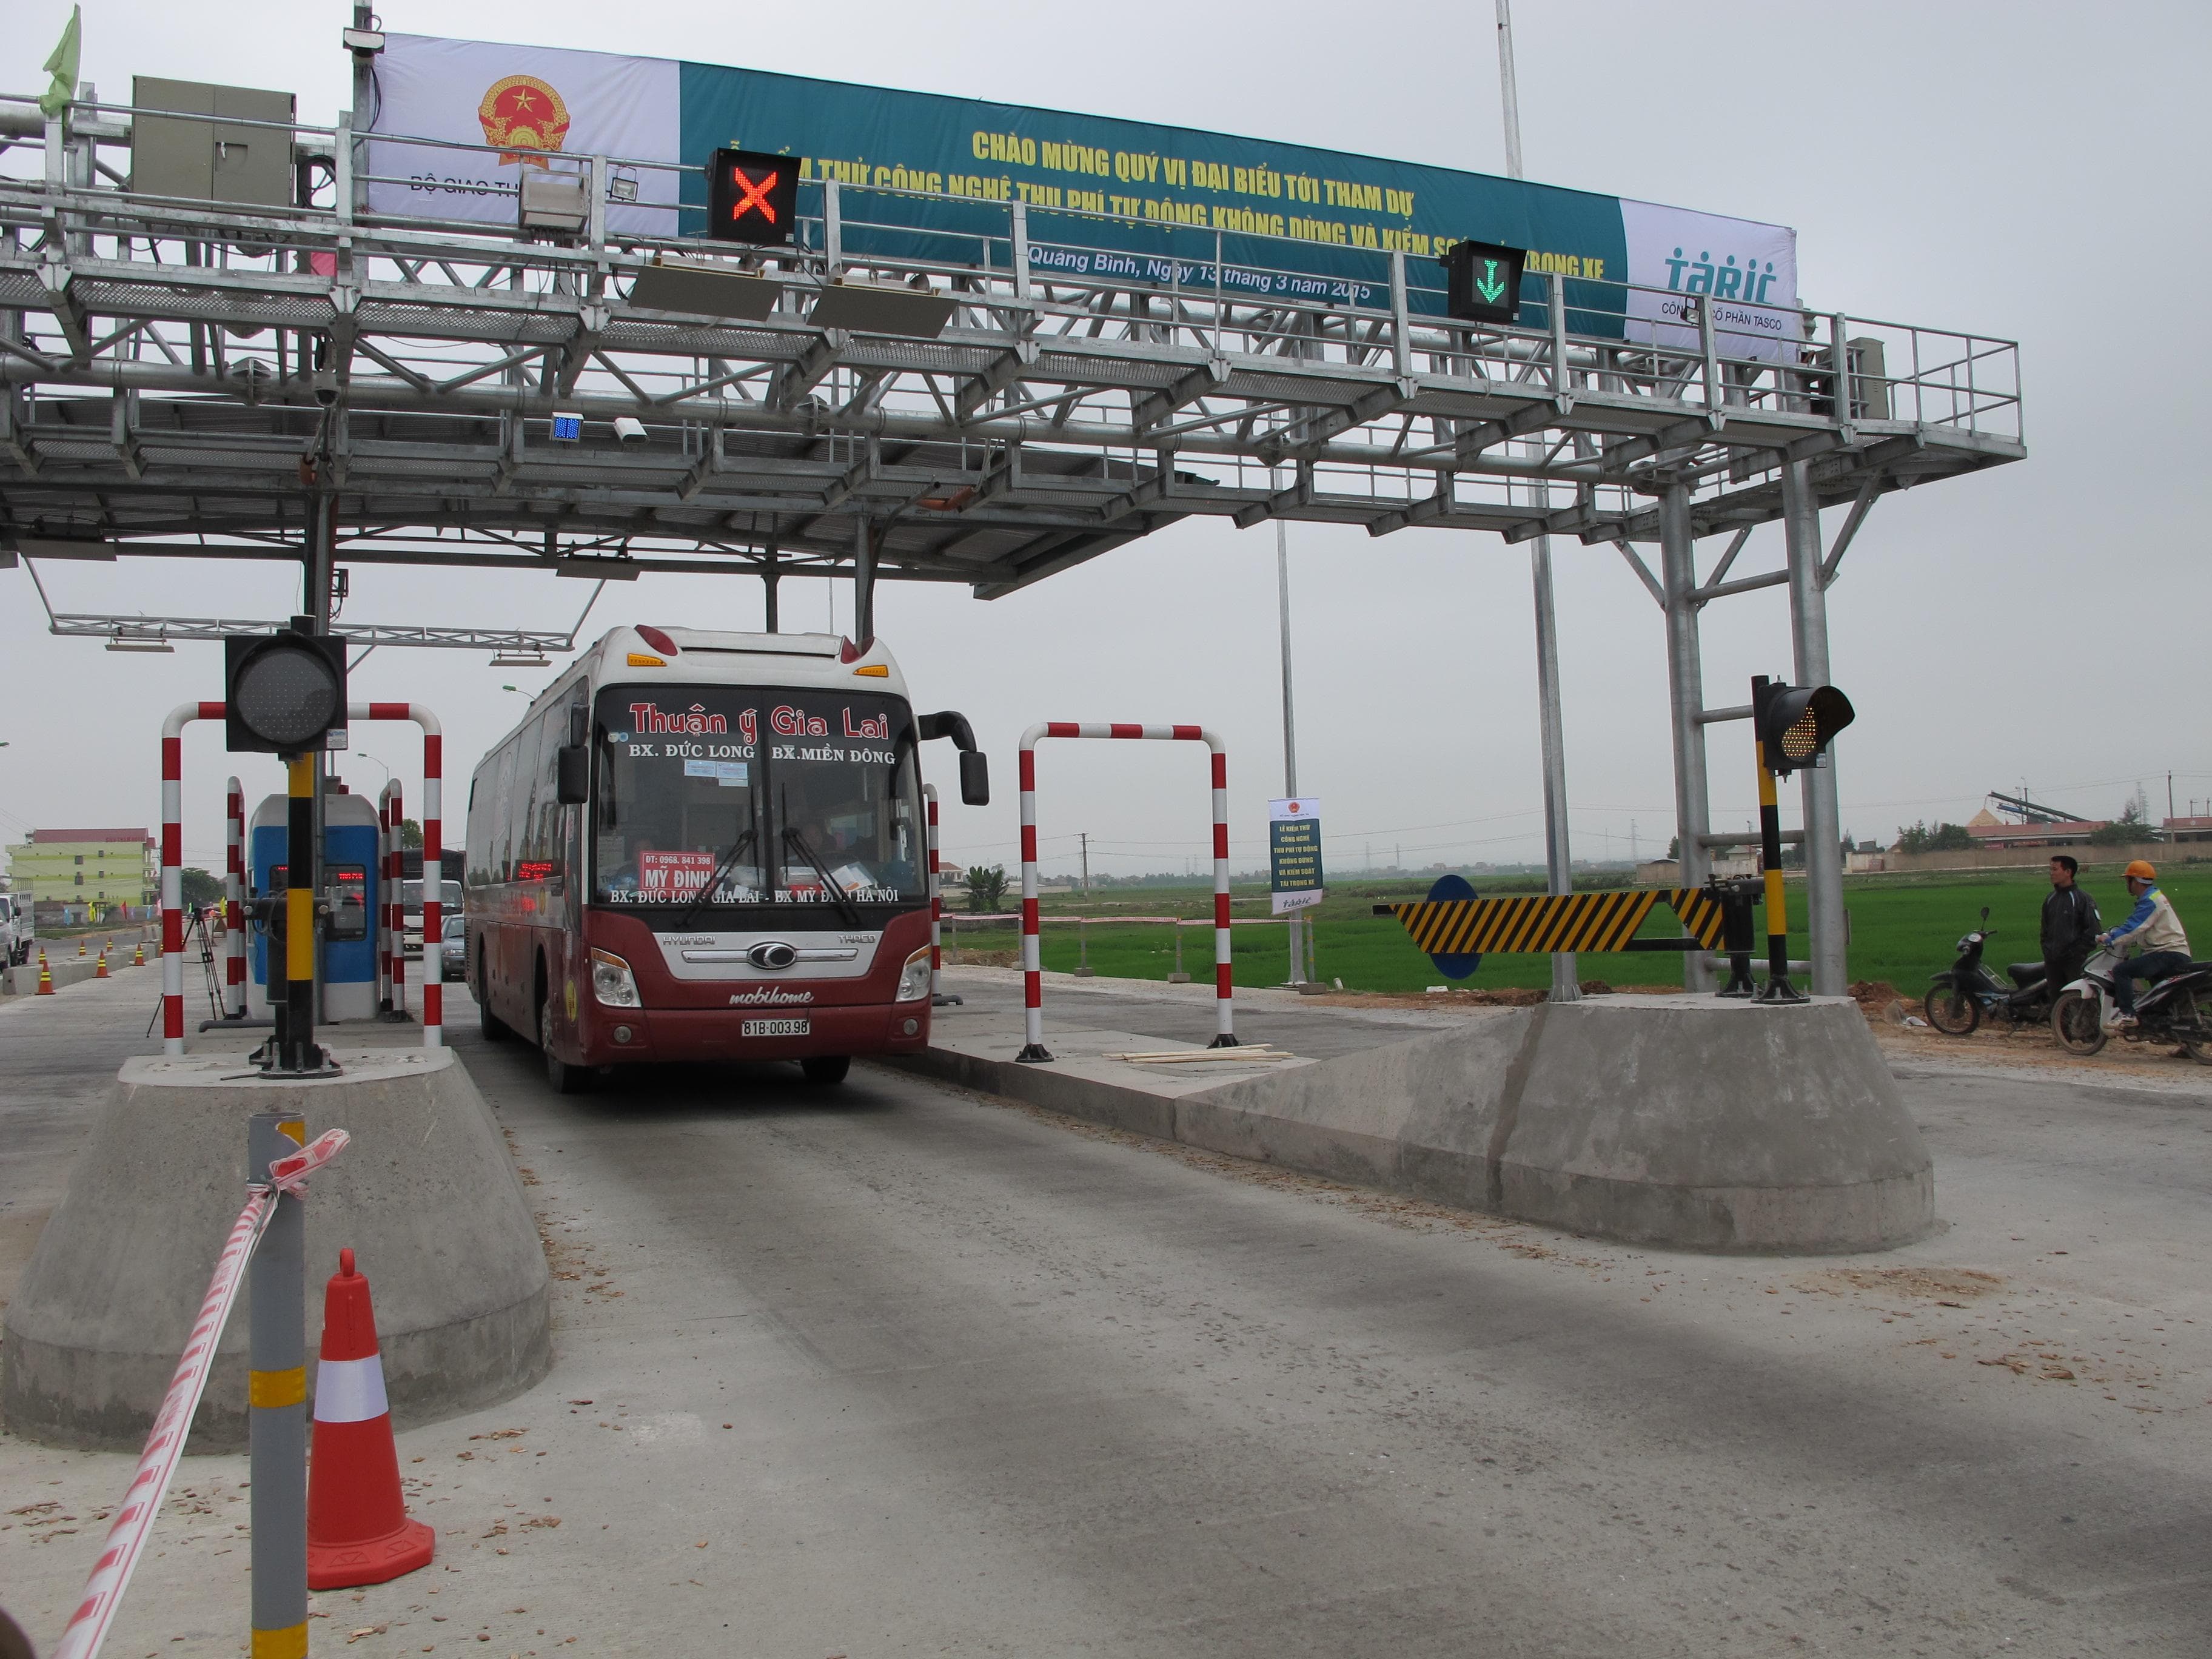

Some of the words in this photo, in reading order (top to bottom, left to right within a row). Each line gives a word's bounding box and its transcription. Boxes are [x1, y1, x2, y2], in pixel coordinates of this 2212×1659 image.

[973, 131, 1036, 166] CHÀO
[1042, 139, 1109, 176] MỪNG
[1115, 151, 1159, 183] QUÝ
[1163, 157, 1187, 190] VỊ
[1191, 159, 1229, 193] ĐẠI
[1233, 162, 1281, 199] BIỂU
[1284, 172, 1320, 204] TỚI
[1324, 179, 1382, 212] THAM
[1386, 188, 1414, 221] DỰ
[874, 163, 942, 202] CÔNG
[948, 174, 1011, 213] NGHỆ
[1067, 189, 1104, 221] PHÍ
[1213, 206, 1284, 238] KHÔNG
[1350, 222, 1378, 249] VÀ
[1382, 225, 1429, 255] KIỂM
[1093, 253, 1140, 278] Bình,
[1276, 275, 1287, 290] 3
[1754, 315, 1781, 331] TASCO
[629, 702, 728, 737] Thuận
[770, 705, 829, 737] Gia
[842, 706, 889, 740] Lai
[629, 744, 659, 757] BX.
[665, 740, 703, 757] ĐỨC
[708, 745, 756, 759] LONG
[850, 748, 896, 765] ĐÔNG
[697, 857, 711, 865] 398
[663, 936, 716, 945] HYUNDAI
[729, 986, 814, 1005] mobihome
